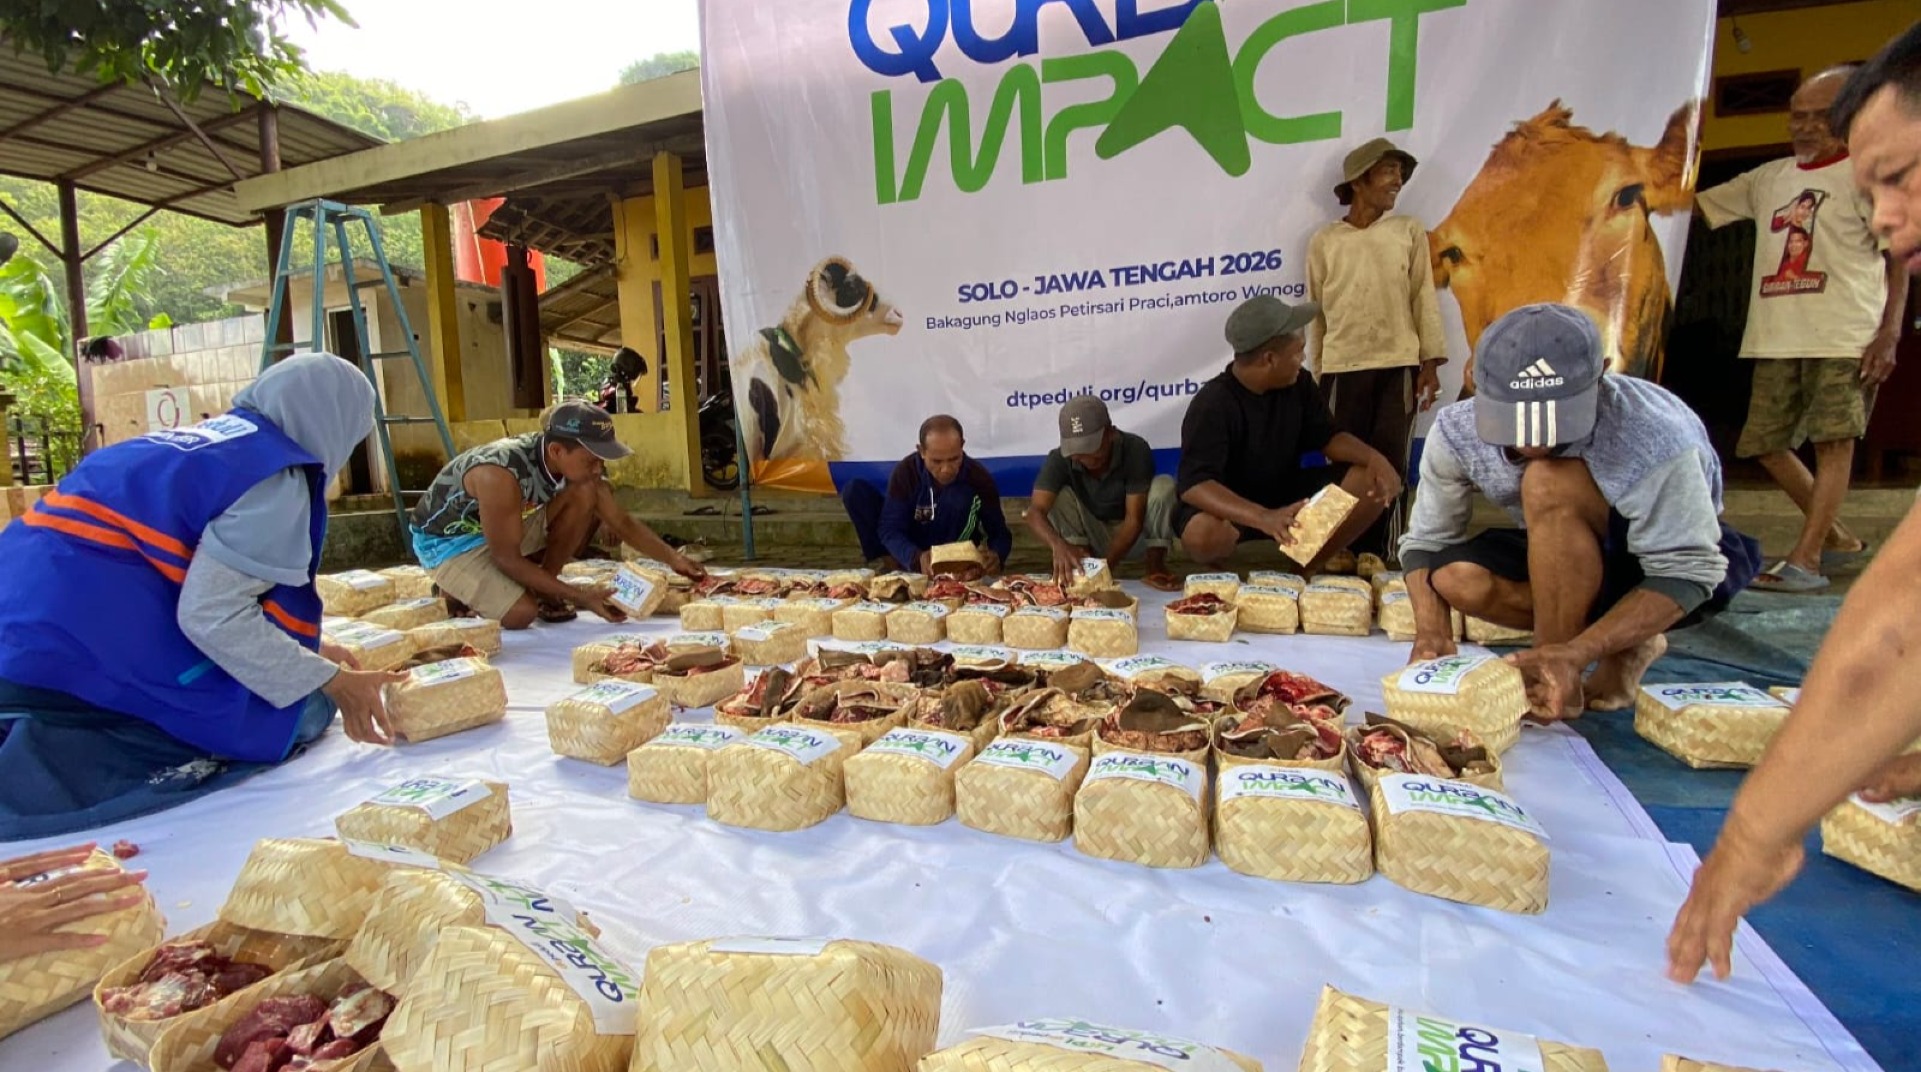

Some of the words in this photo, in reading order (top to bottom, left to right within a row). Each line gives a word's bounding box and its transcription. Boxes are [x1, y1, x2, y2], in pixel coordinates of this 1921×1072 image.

[871, 0, 1466, 204] IMPACT
[959, 279, 1019, 303] SOLO
[1034, 269, 1106, 295] JAWA
[1109, 257, 1215, 287] TENGAH
[1219, 249, 1283, 276] 2026
[926, 313, 1001, 330] Bakagung
[1005, 307, 1056, 325] Nglaos
[1060, 298, 1125, 318] Petirsari
[1509, 377, 1564, 390] adidas
[1239, 772, 1345, 793] QURBAN
[1402, 782, 1524, 815] QURBAN
